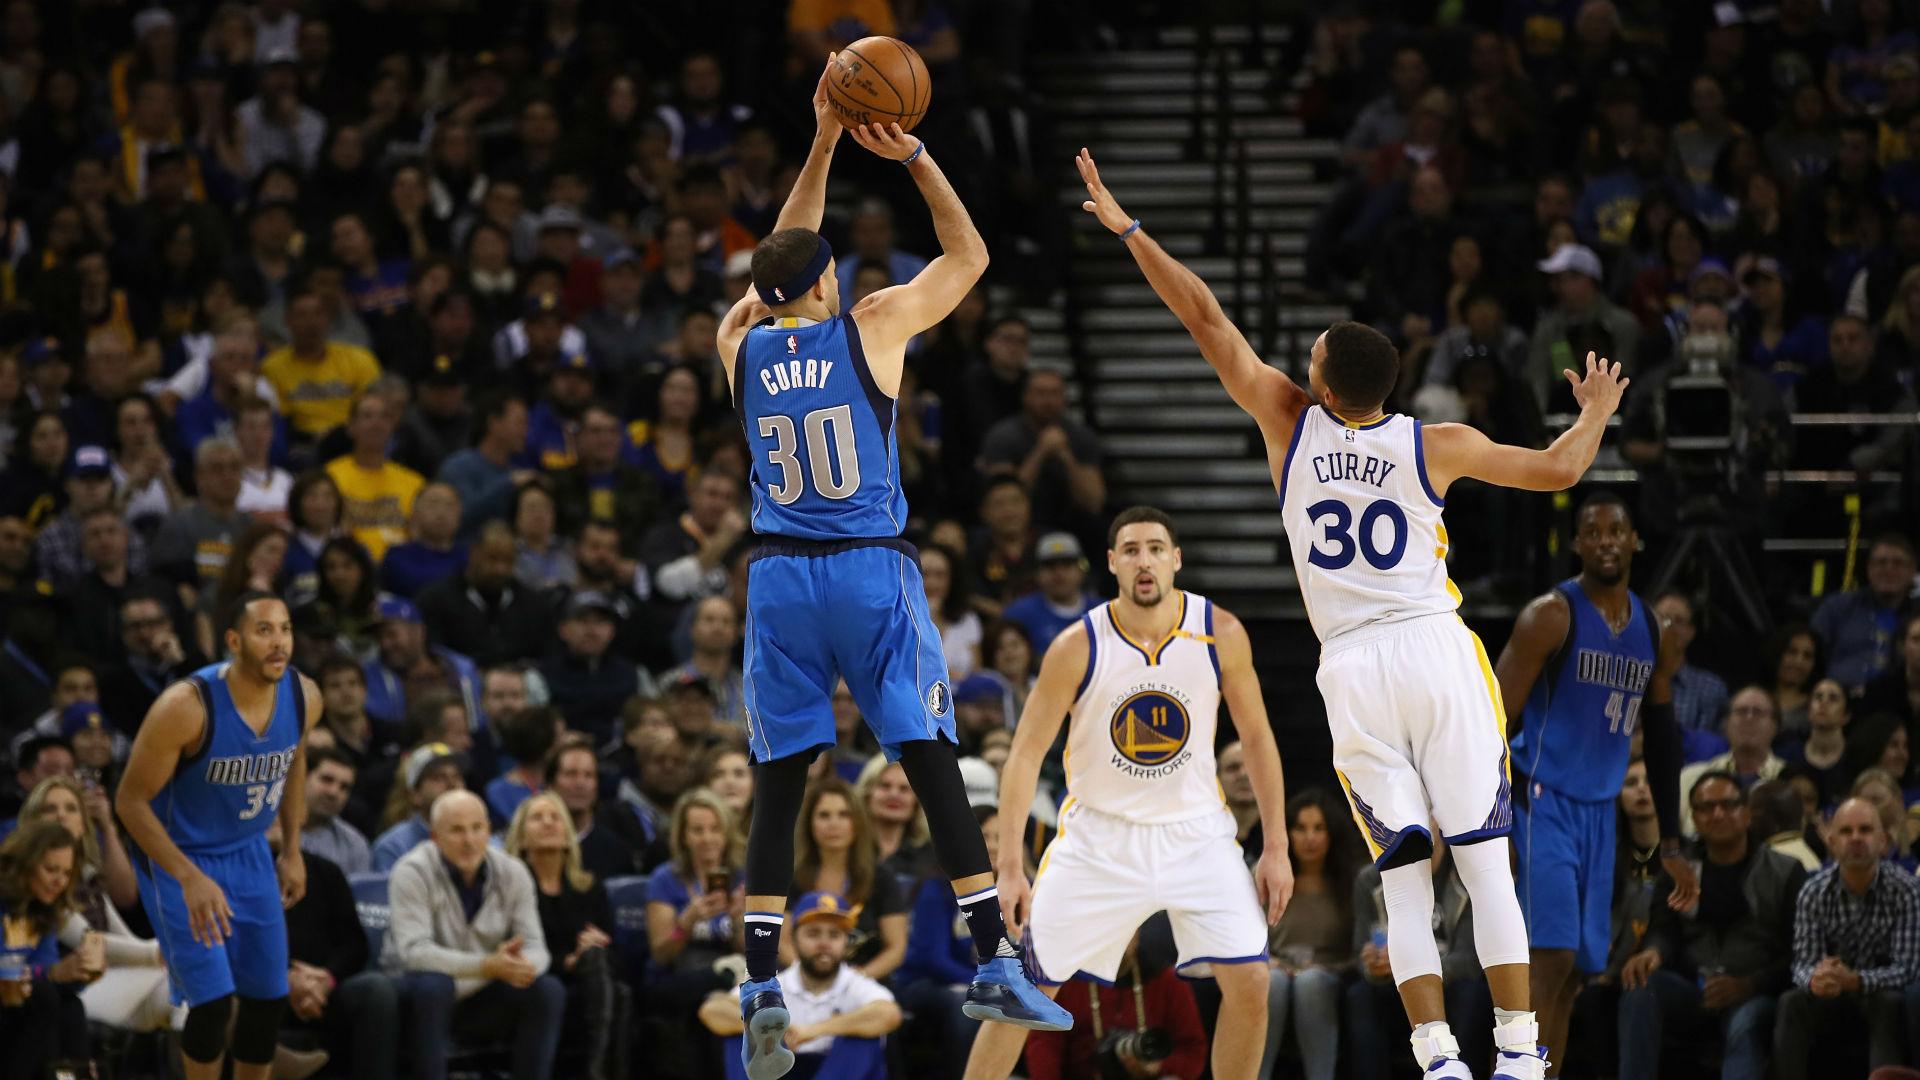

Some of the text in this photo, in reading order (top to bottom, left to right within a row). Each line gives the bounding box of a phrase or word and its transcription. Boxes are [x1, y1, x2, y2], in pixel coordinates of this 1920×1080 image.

[760, 359, 833, 396] CURRY
[757, 404, 861, 505] 30
[1312, 452, 1396, 488] CURRY
[1305, 499, 1408, 570] 30
[1577, 648, 1653, 693] DALLAS
[1110, 682, 1192, 709] GOLDEN STATE
[1151, 705, 1167, 727] 11
[1604, 691, 1642, 737] 40
[205, 744, 297, 785] DALLAS
[1111, 750, 1192, 779] WARRIORS
[239, 777, 287, 820] 34
